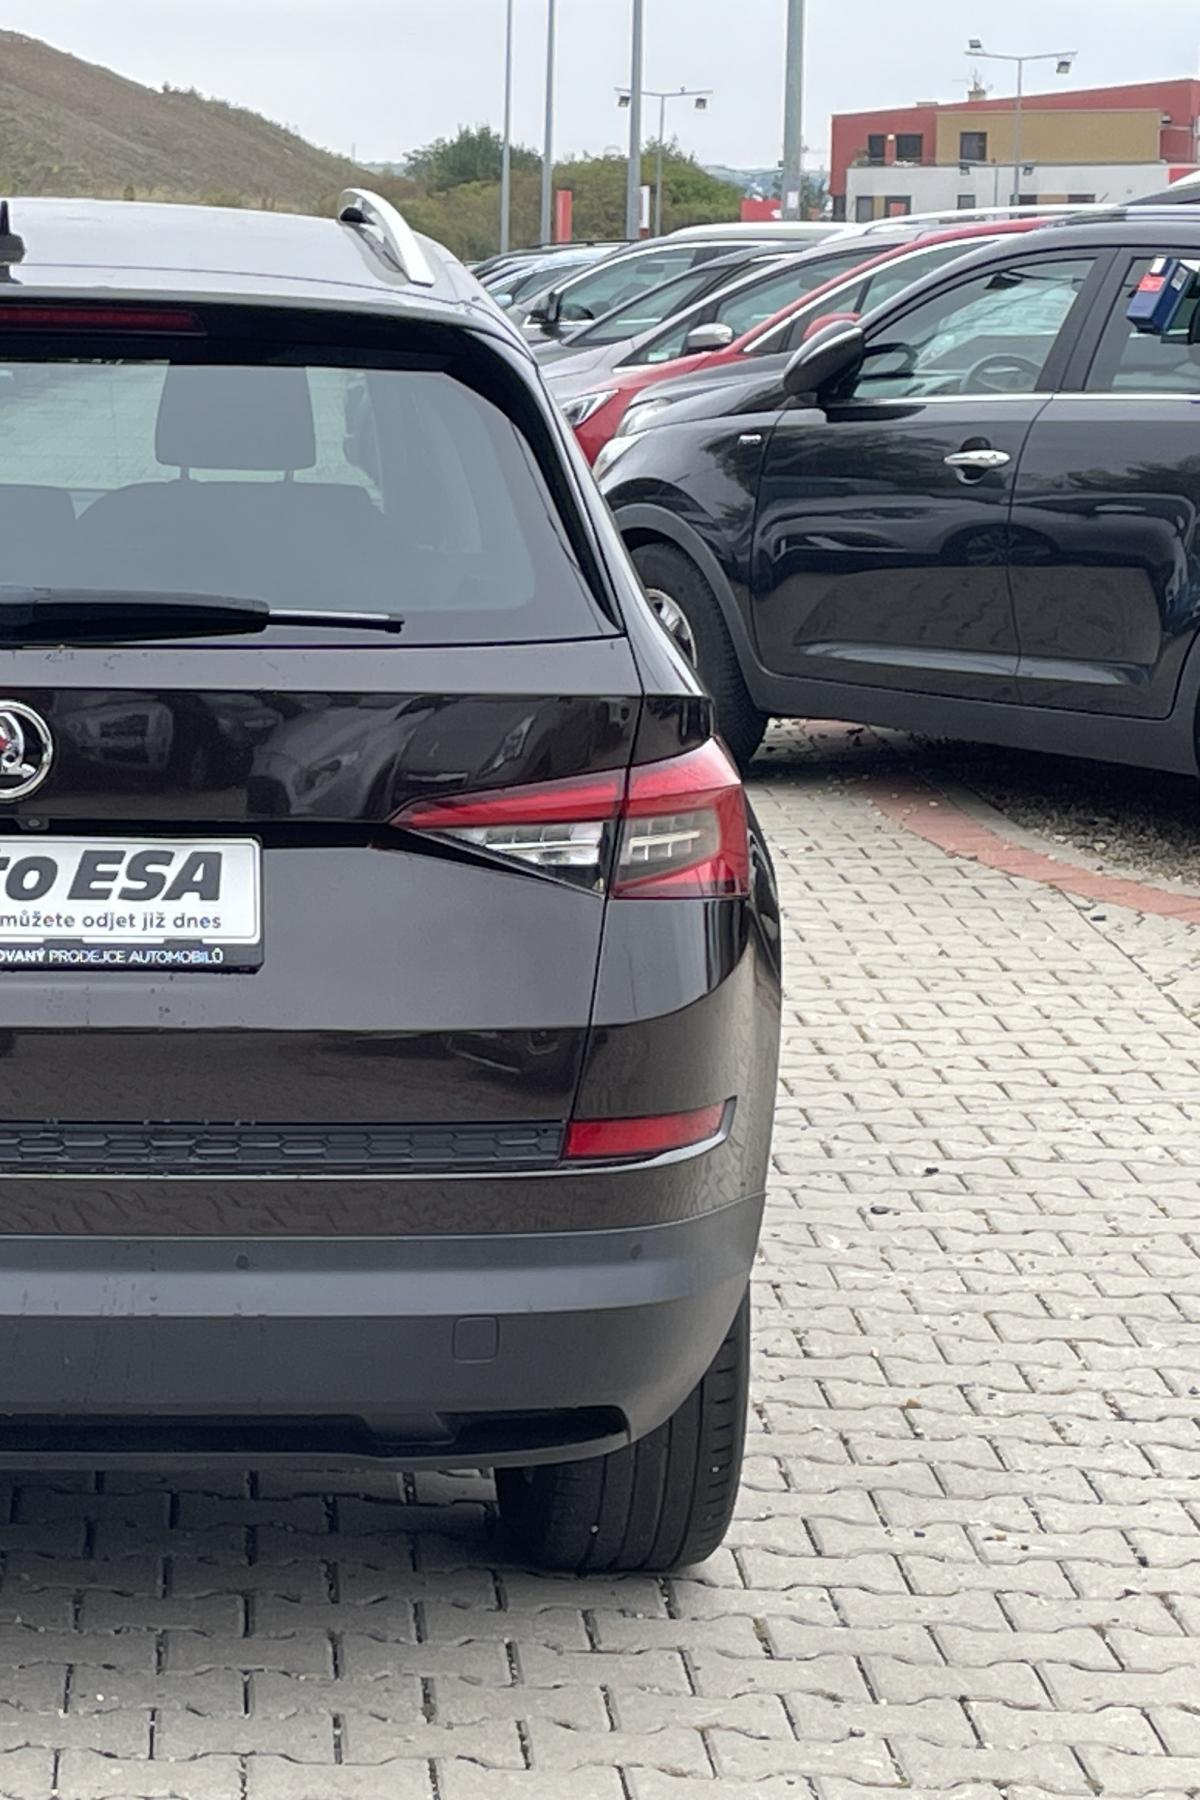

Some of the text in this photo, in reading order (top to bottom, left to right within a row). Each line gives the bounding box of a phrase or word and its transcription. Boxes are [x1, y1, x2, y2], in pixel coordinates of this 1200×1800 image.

[67, 849, 223, 902] ESA
[0, 909, 76, 928] můžete
[82, 912, 136, 931] odjet
[141, 911, 166, 931] již
[172, 912, 222, 929] dnes
[49, 949, 126, 964] PRODEJCE
[128, 947, 224, 964] AUTOMOBILŮ
